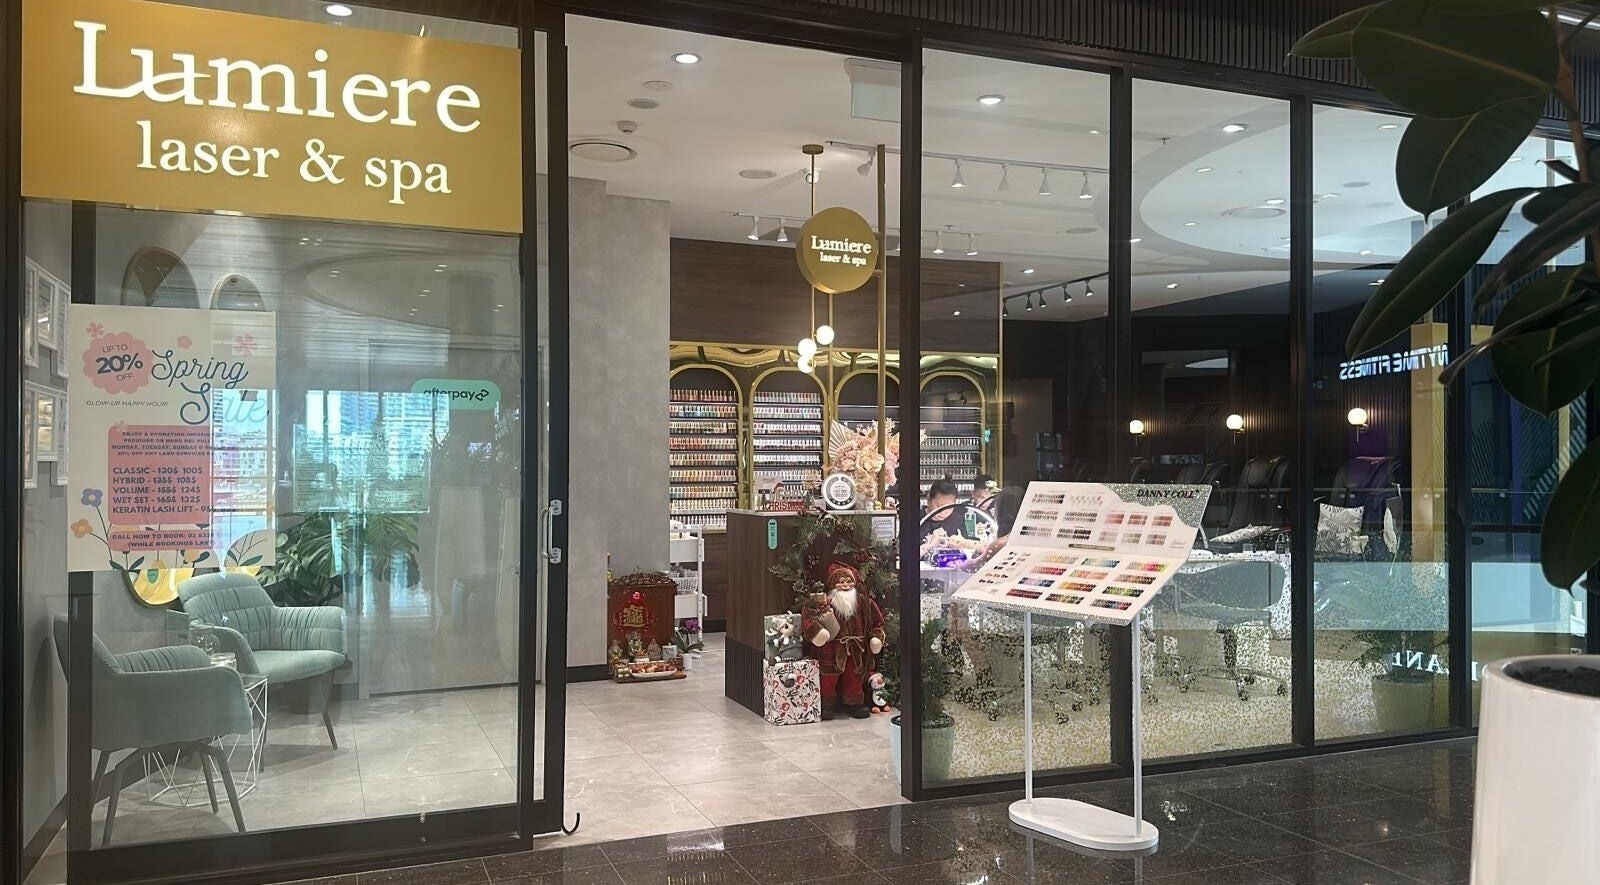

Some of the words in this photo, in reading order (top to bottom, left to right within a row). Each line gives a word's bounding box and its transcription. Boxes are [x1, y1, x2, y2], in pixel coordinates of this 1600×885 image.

[73, 20, 481, 132] Lumiere
[136, 120, 280, 178] laser
[299, 138, 345, 184] &
[365, 156, 451, 205] spa
[811, 235, 872, 254] Lumiere
[820, 252, 841, 263] laser
[842, 254, 851, 264] &
[852, 257, 867, 267] spa
[102, 345, 114, 353] UP
[96, 352, 143, 374] 20%
[151, 350, 248, 389] Spring
[116, 373, 134, 381] OFF
[423, 387, 475, 400] afterpay
[1136, 489, 1171, 498] DANNY
